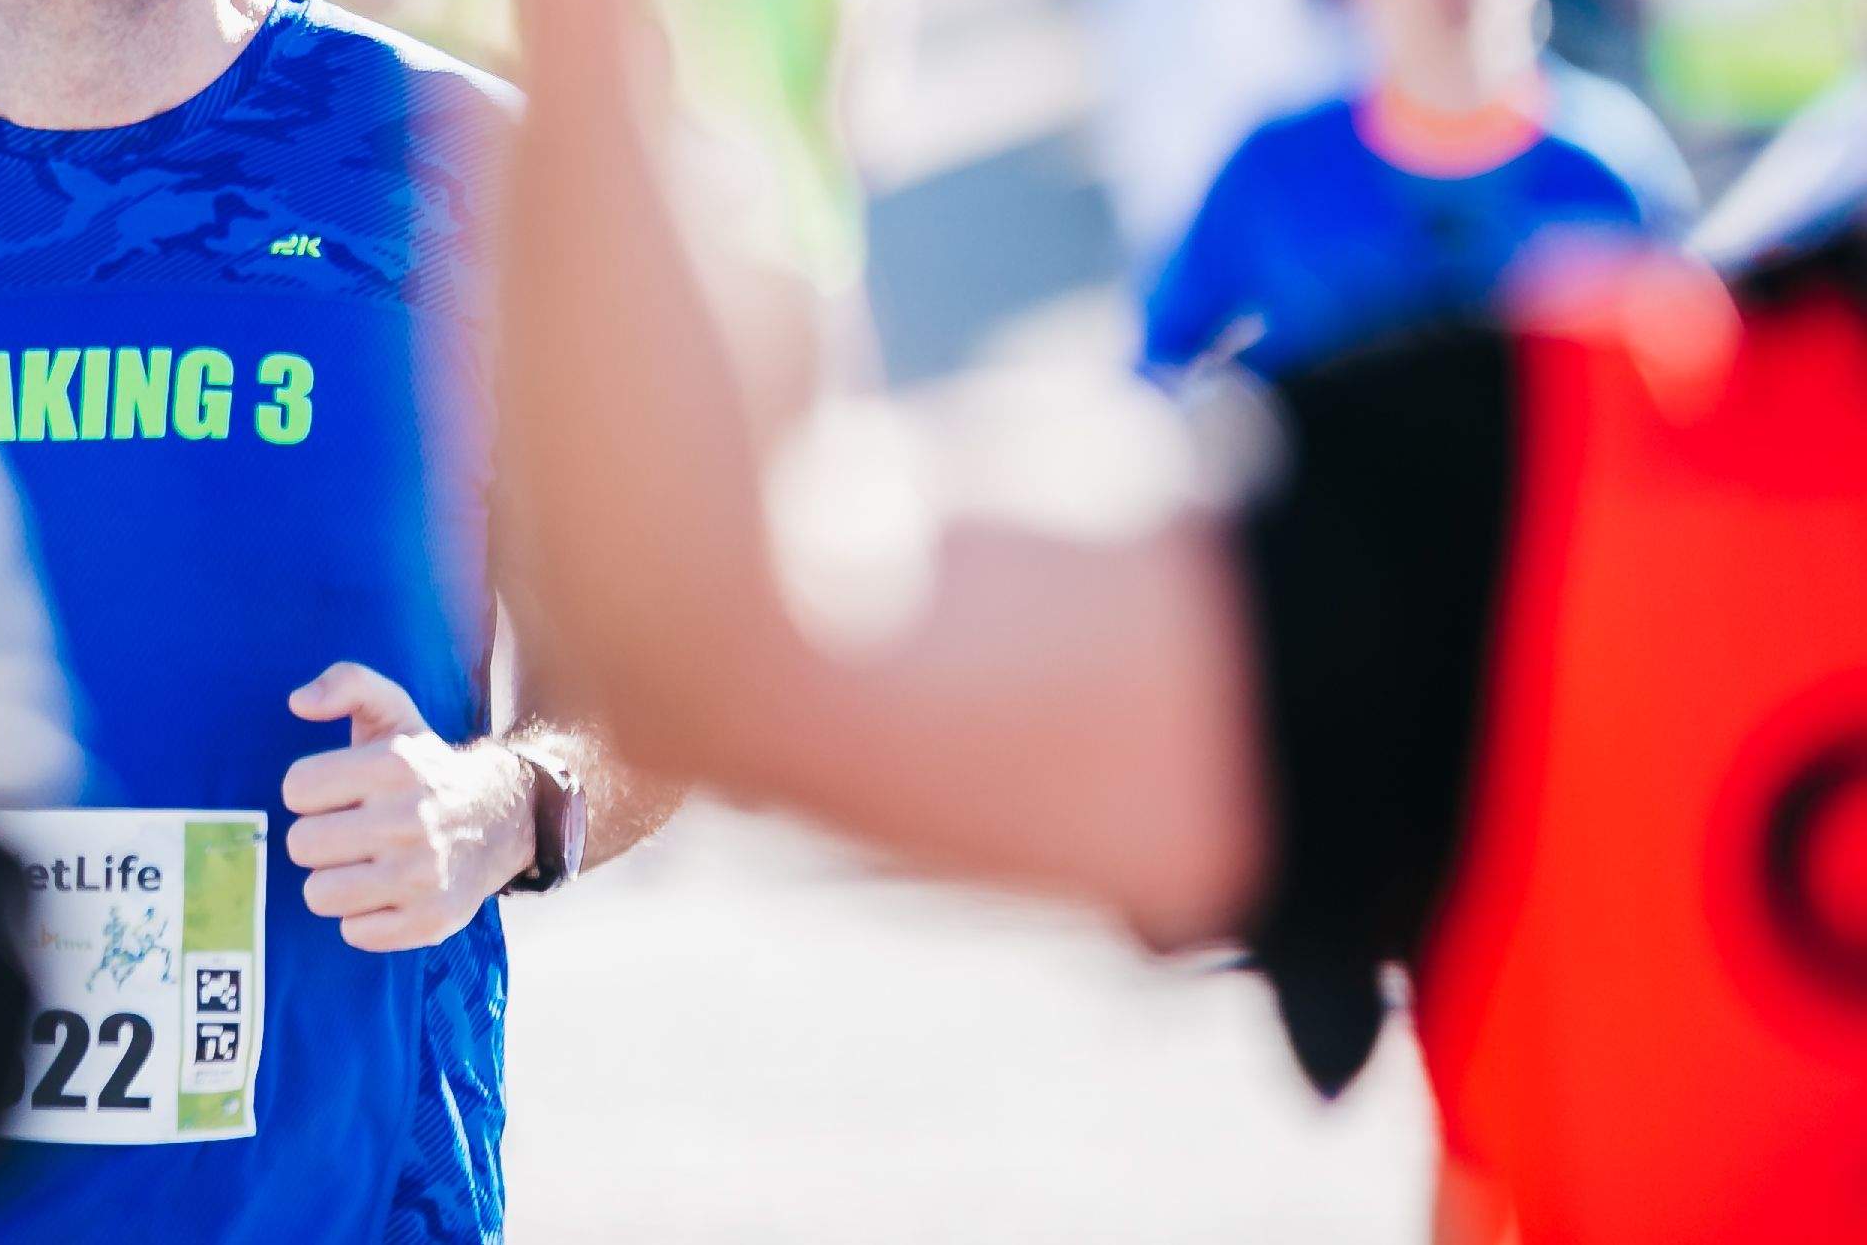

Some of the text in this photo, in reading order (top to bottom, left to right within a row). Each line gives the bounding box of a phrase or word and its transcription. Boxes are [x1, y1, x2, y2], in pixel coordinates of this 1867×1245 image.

[256, 353, 315, 445] 3
[28, 854, 163, 893] etLife
[22, 1009, 155, 1111] 22
